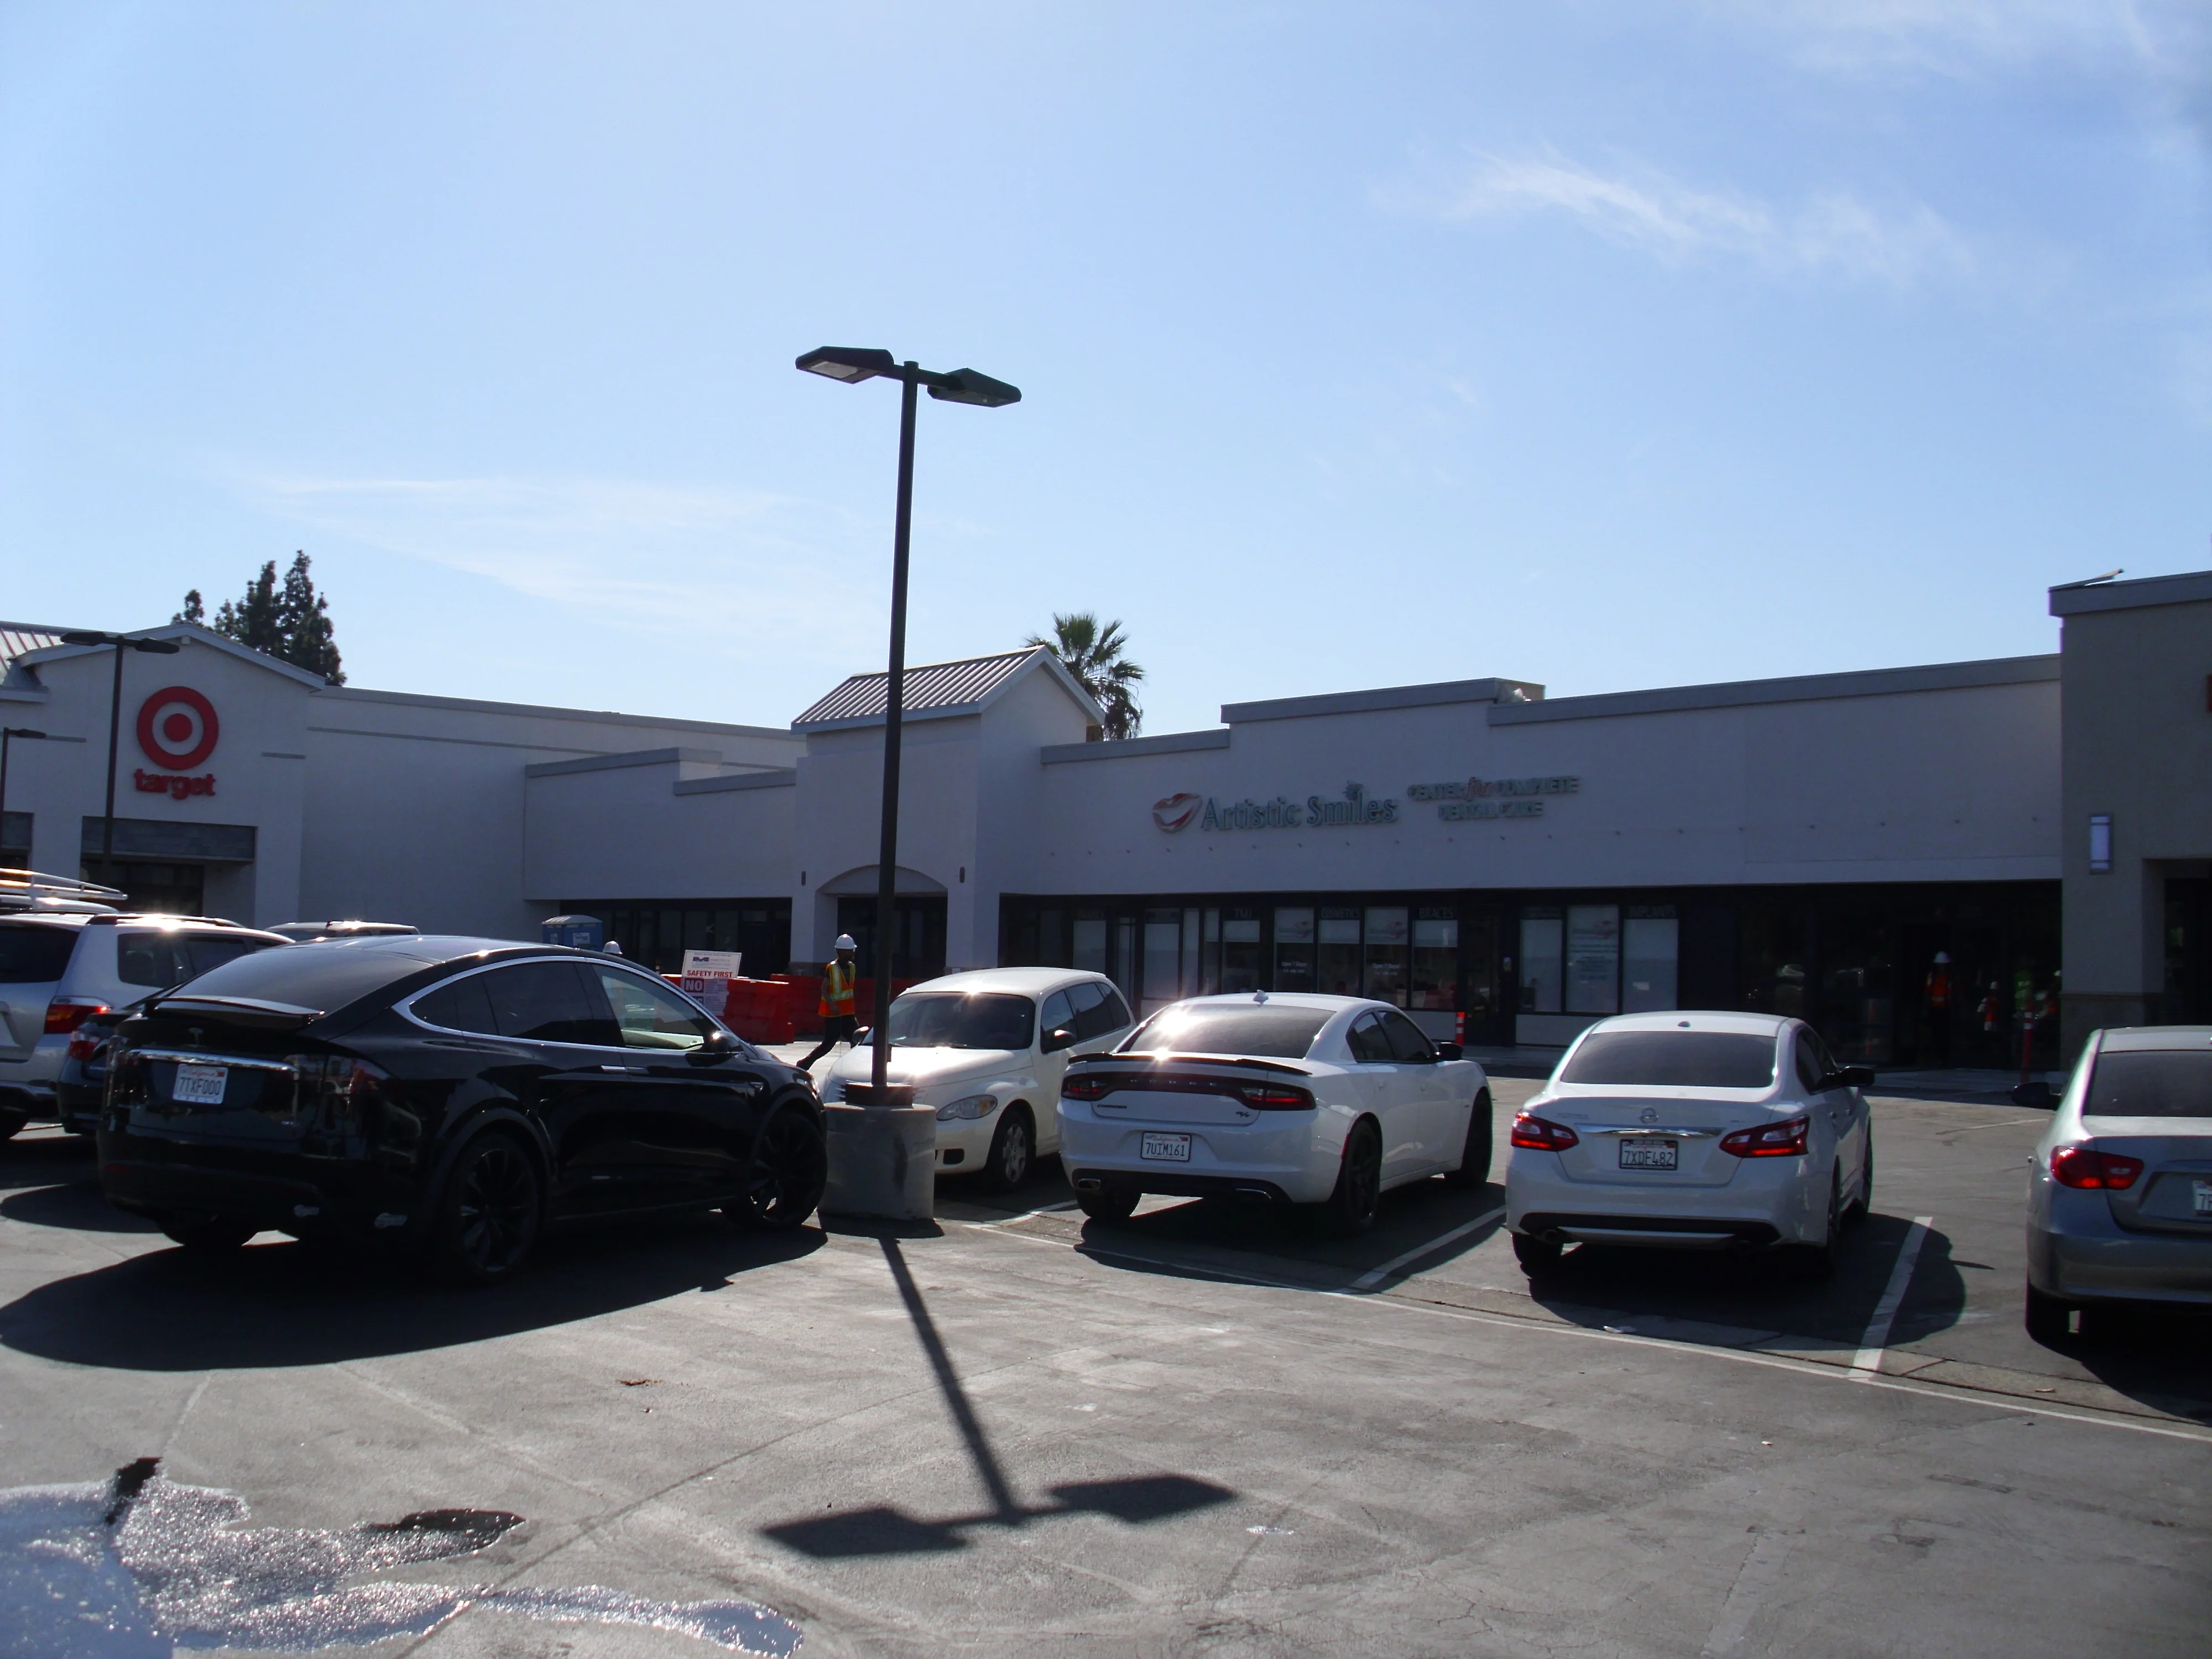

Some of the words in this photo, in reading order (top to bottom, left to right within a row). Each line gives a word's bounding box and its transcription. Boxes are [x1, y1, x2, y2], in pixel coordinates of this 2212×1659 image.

[134, 769, 216, 800] target
[1407, 782, 1463, 800] CENTER
[1464, 776, 1493, 801] for
[1201, 796, 1300, 829] Artistic
[1306, 784, 1400, 826] Smiles
[1438, 803, 1498, 821] DENTAL
[1499, 801, 1545, 818] CARE
[1234, 908, 1252, 920] TMJ
[1321, 907, 1360, 919] COSMETICS
[1419, 907, 1454, 919] BRACES
[1628, 905, 1677, 919] IMPLANTS
[686, 979, 703, 992] NO
[179, 1077, 222, 1096] 7TXF000
[1146, 1142, 1186, 1157] 7UIM161
[1624, 1151, 1673, 1166] 7XDF482
